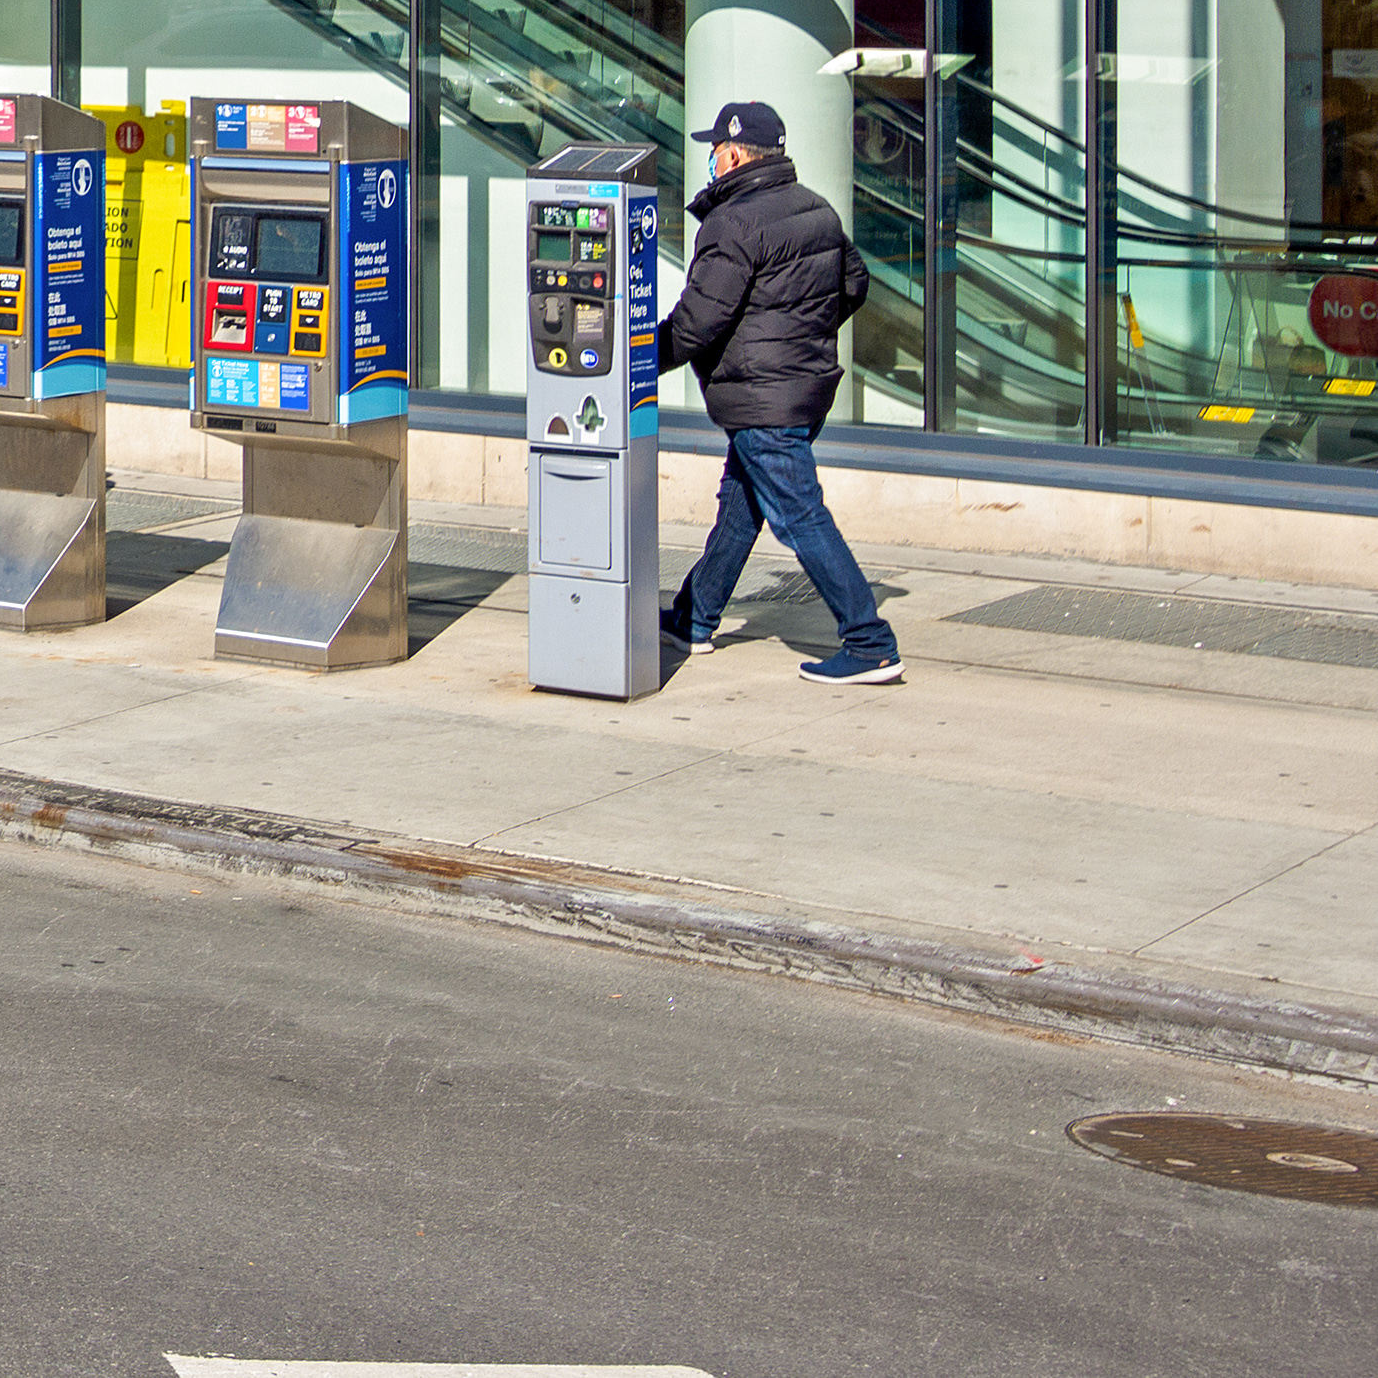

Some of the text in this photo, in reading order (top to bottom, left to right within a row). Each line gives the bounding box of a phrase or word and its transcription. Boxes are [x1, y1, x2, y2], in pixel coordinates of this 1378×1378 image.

[106, 208, 129, 217] ION
[48, 227, 74, 238] Obtenga
[106, 223, 128, 233] ADO
[48, 240, 68, 251] boleto
[106, 238, 133, 248] TION
[355, 242, 379, 253] Obtenga
[355, 255, 373, 267] boleto
[630, 264, 643, 280] Get
[218, 285, 244, 294] RECEIPT
[265, 288, 282, 298] PUSH
[630, 283, 652, 299] Ticket
[299, 291, 322, 300] METRO
[301, 299, 319, 307] CARD
[263, 304, 283, 313] START
[630, 304, 647, 318] Here
[1323, 300, 1354, 319] No
